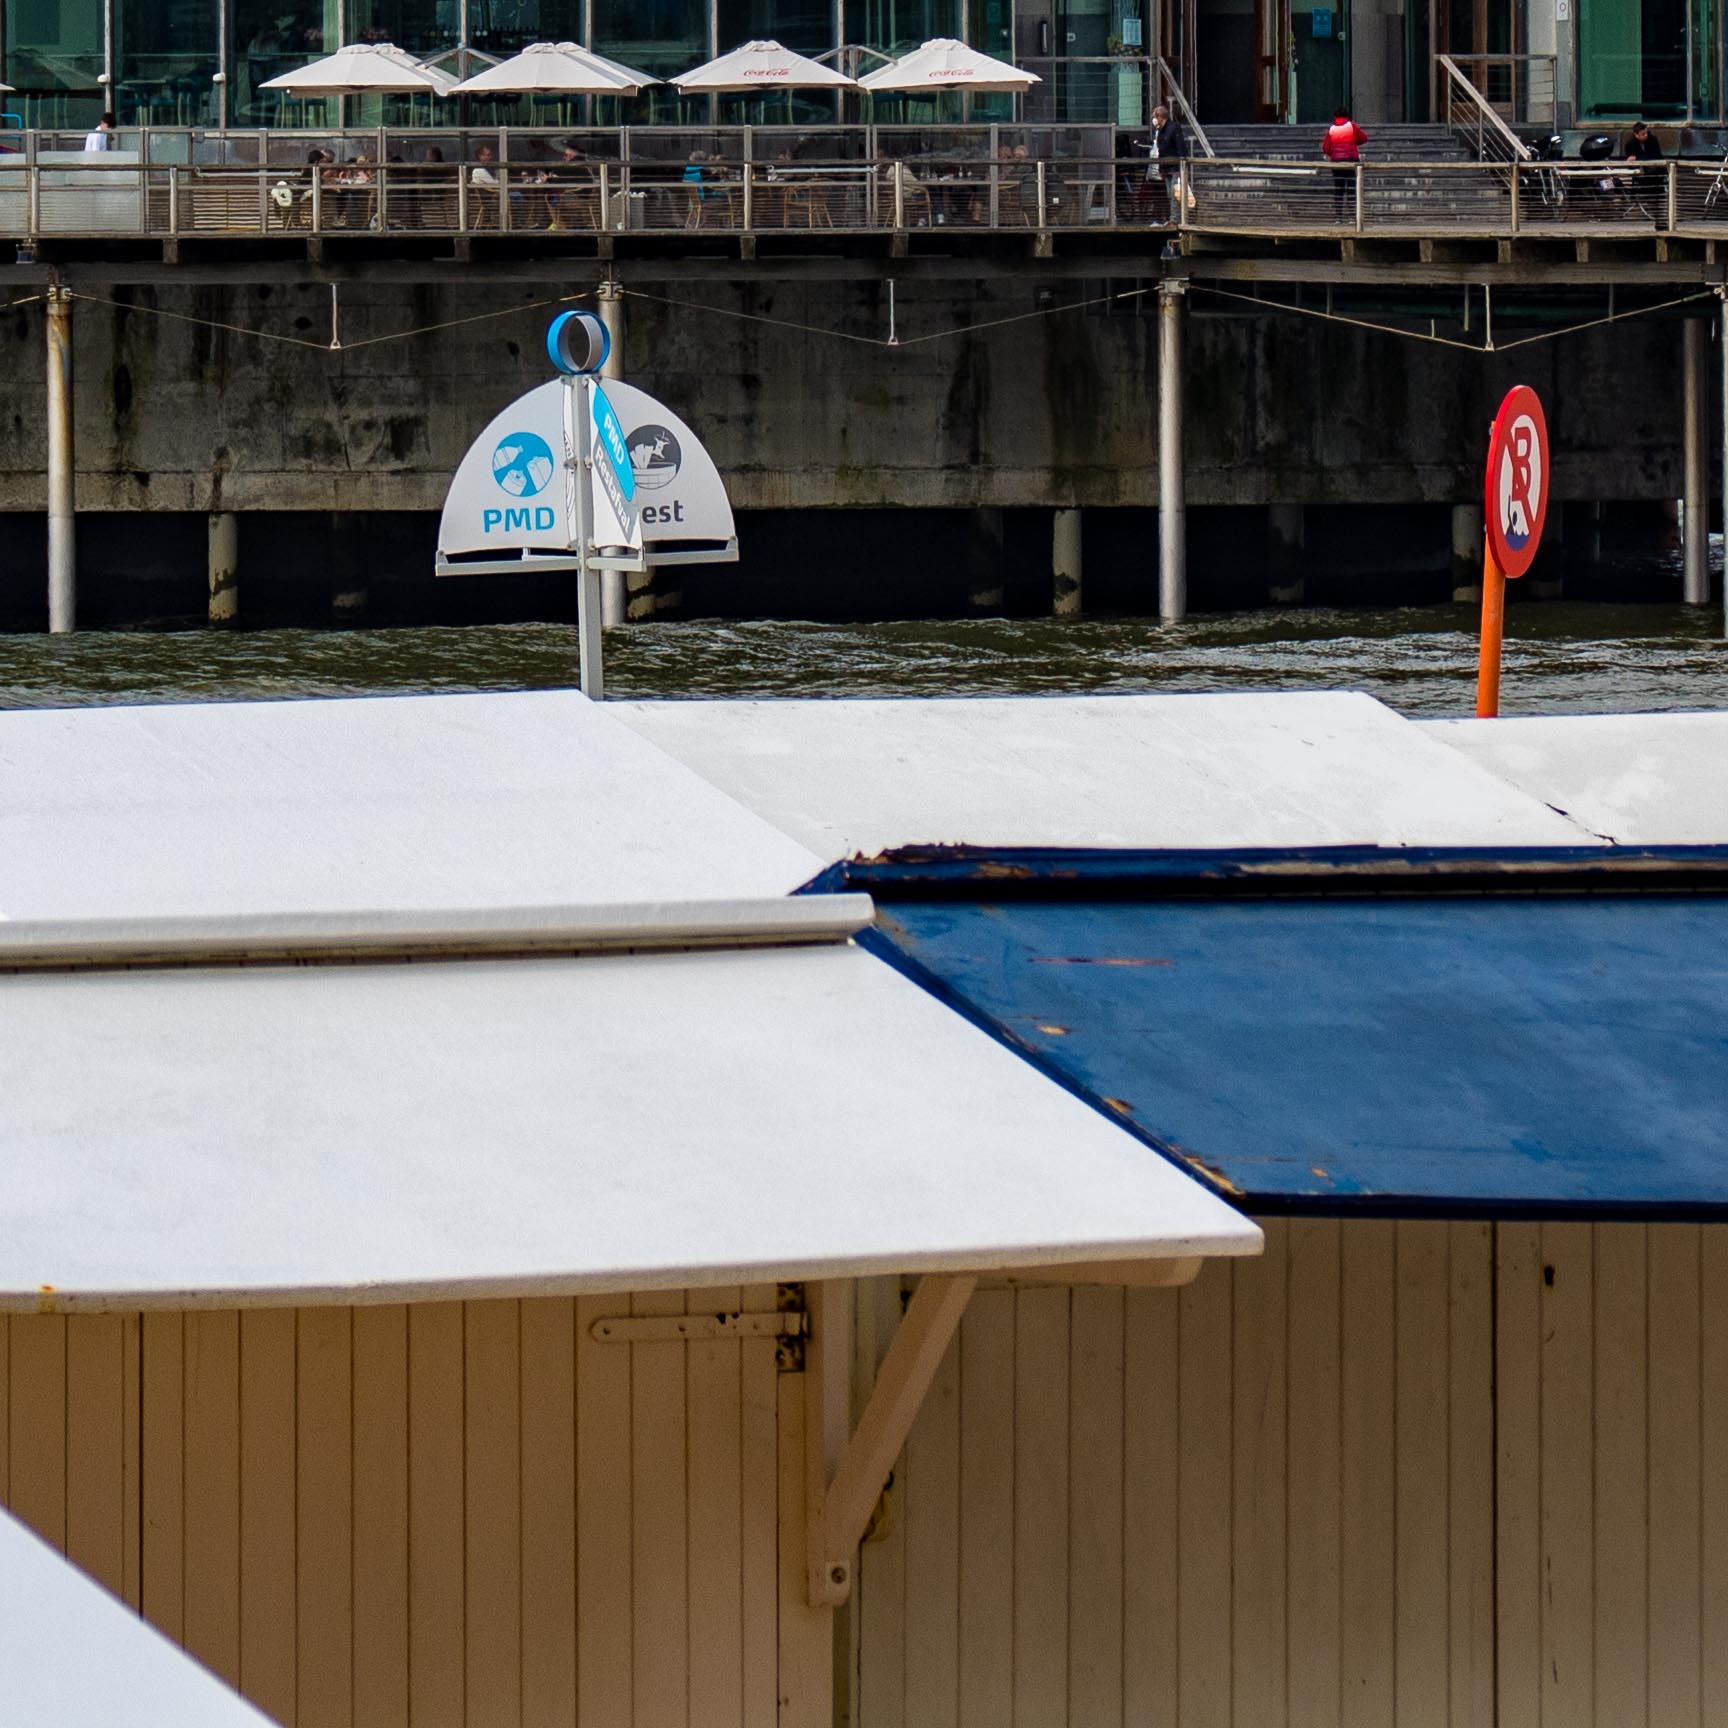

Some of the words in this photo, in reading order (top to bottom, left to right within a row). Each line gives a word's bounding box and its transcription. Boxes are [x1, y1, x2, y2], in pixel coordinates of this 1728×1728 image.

[603, 413, 625, 465] PMD
[595, 444, 631, 534] Restafval
[483, 506, 555, 533] PMD
[642, 500, 684, 524] est
